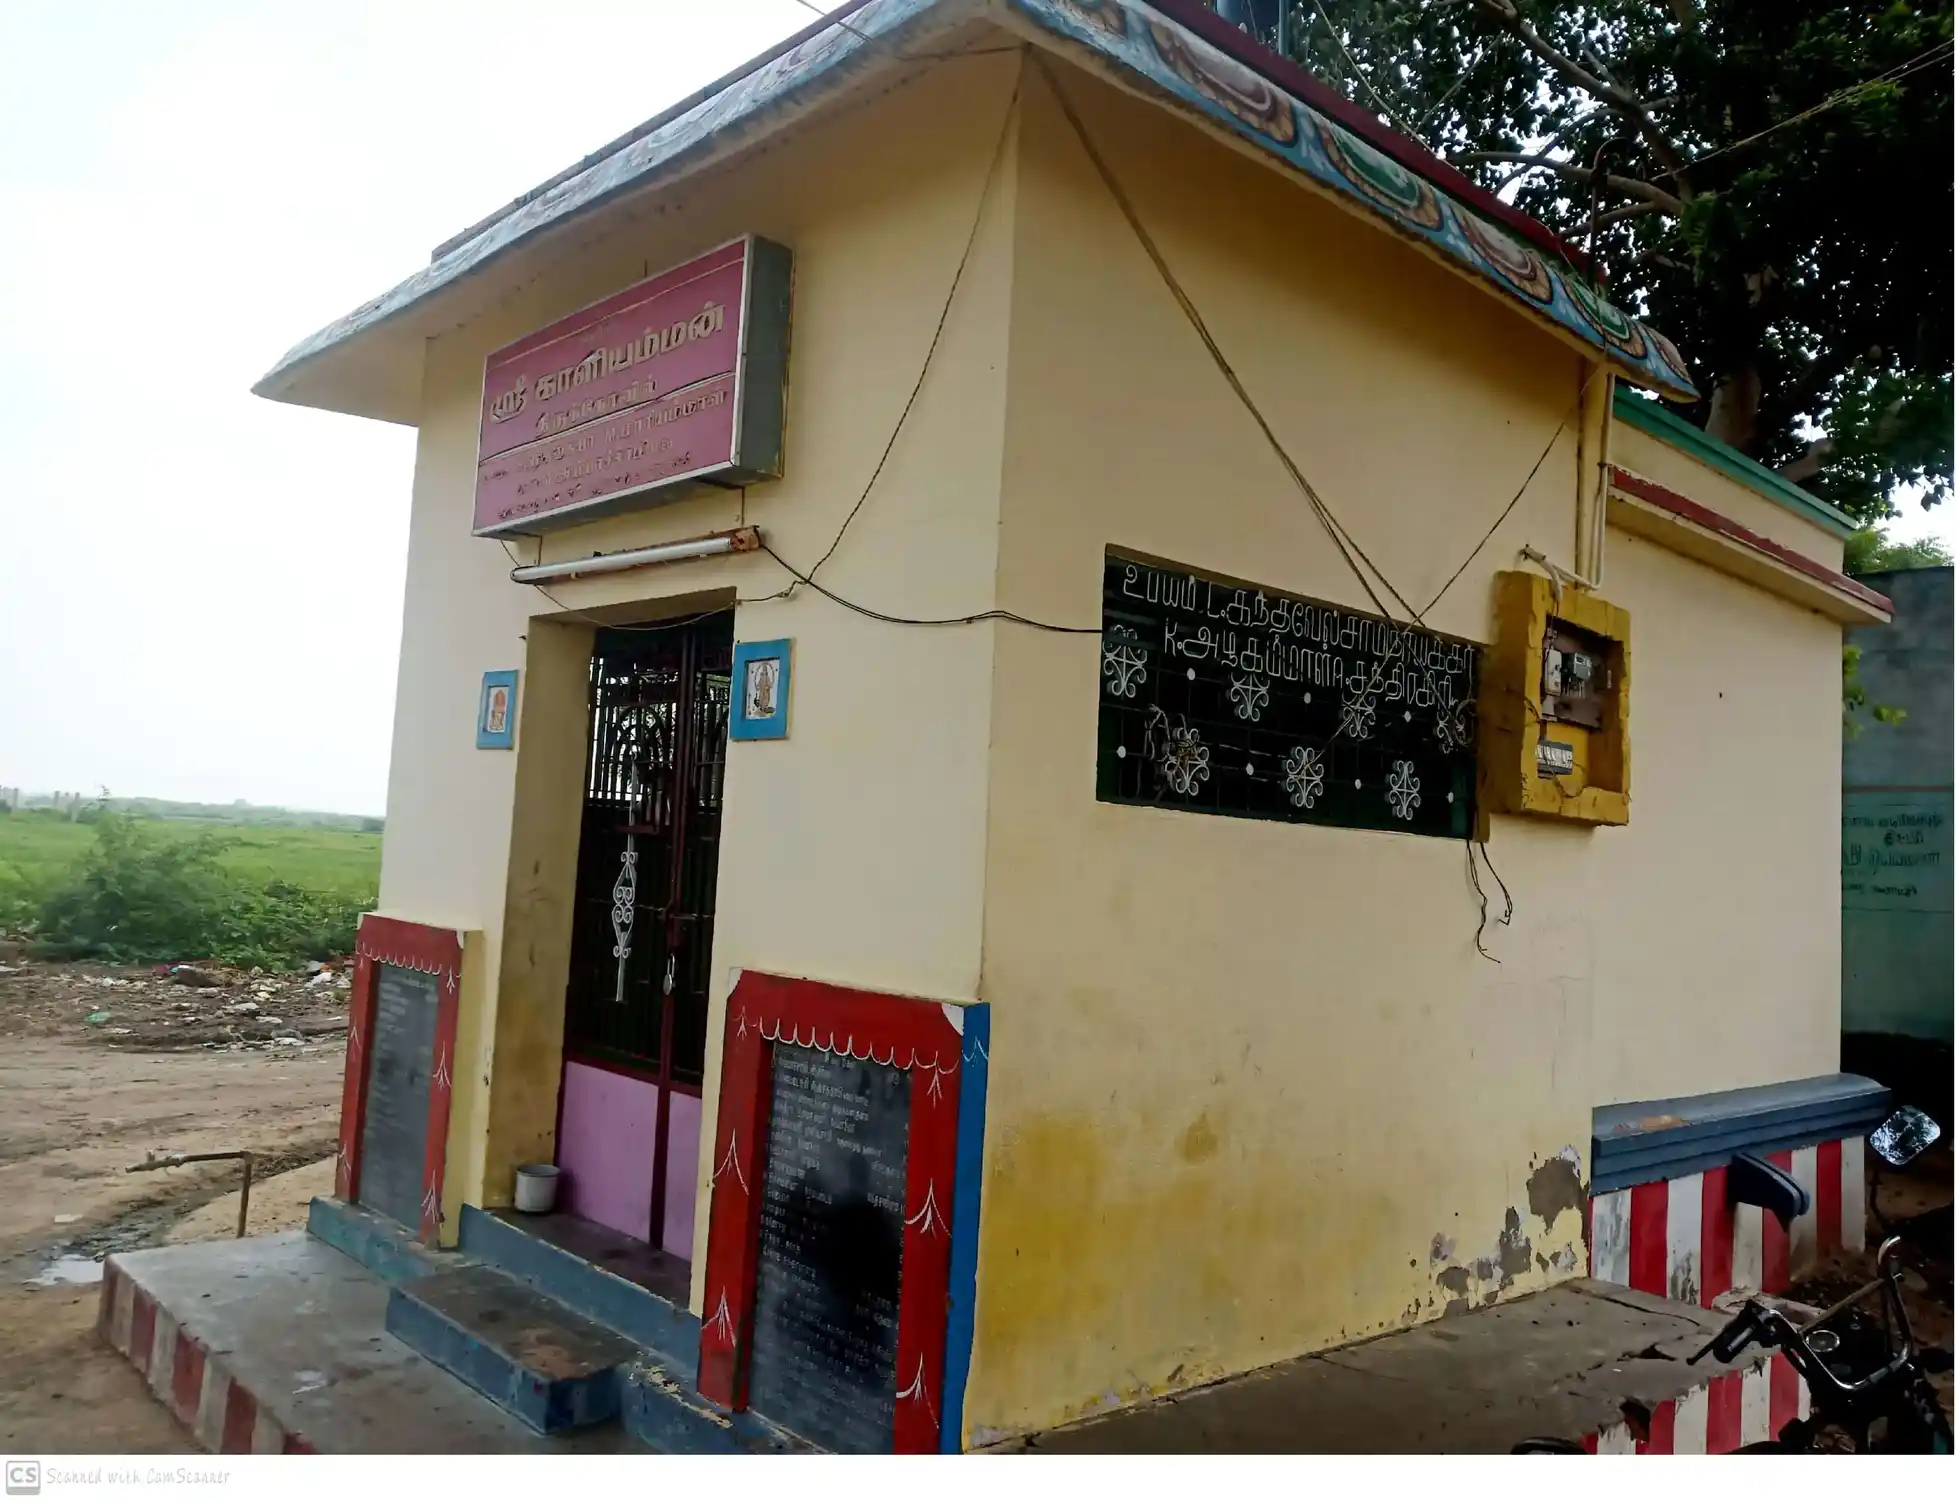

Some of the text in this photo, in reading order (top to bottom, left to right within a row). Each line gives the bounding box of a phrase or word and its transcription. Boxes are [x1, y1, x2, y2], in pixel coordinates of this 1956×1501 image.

[488, 301, 726, 424] ஸ்ரீ காளியம்மன்
[1123, 564, 1197, 611] உபயம்
